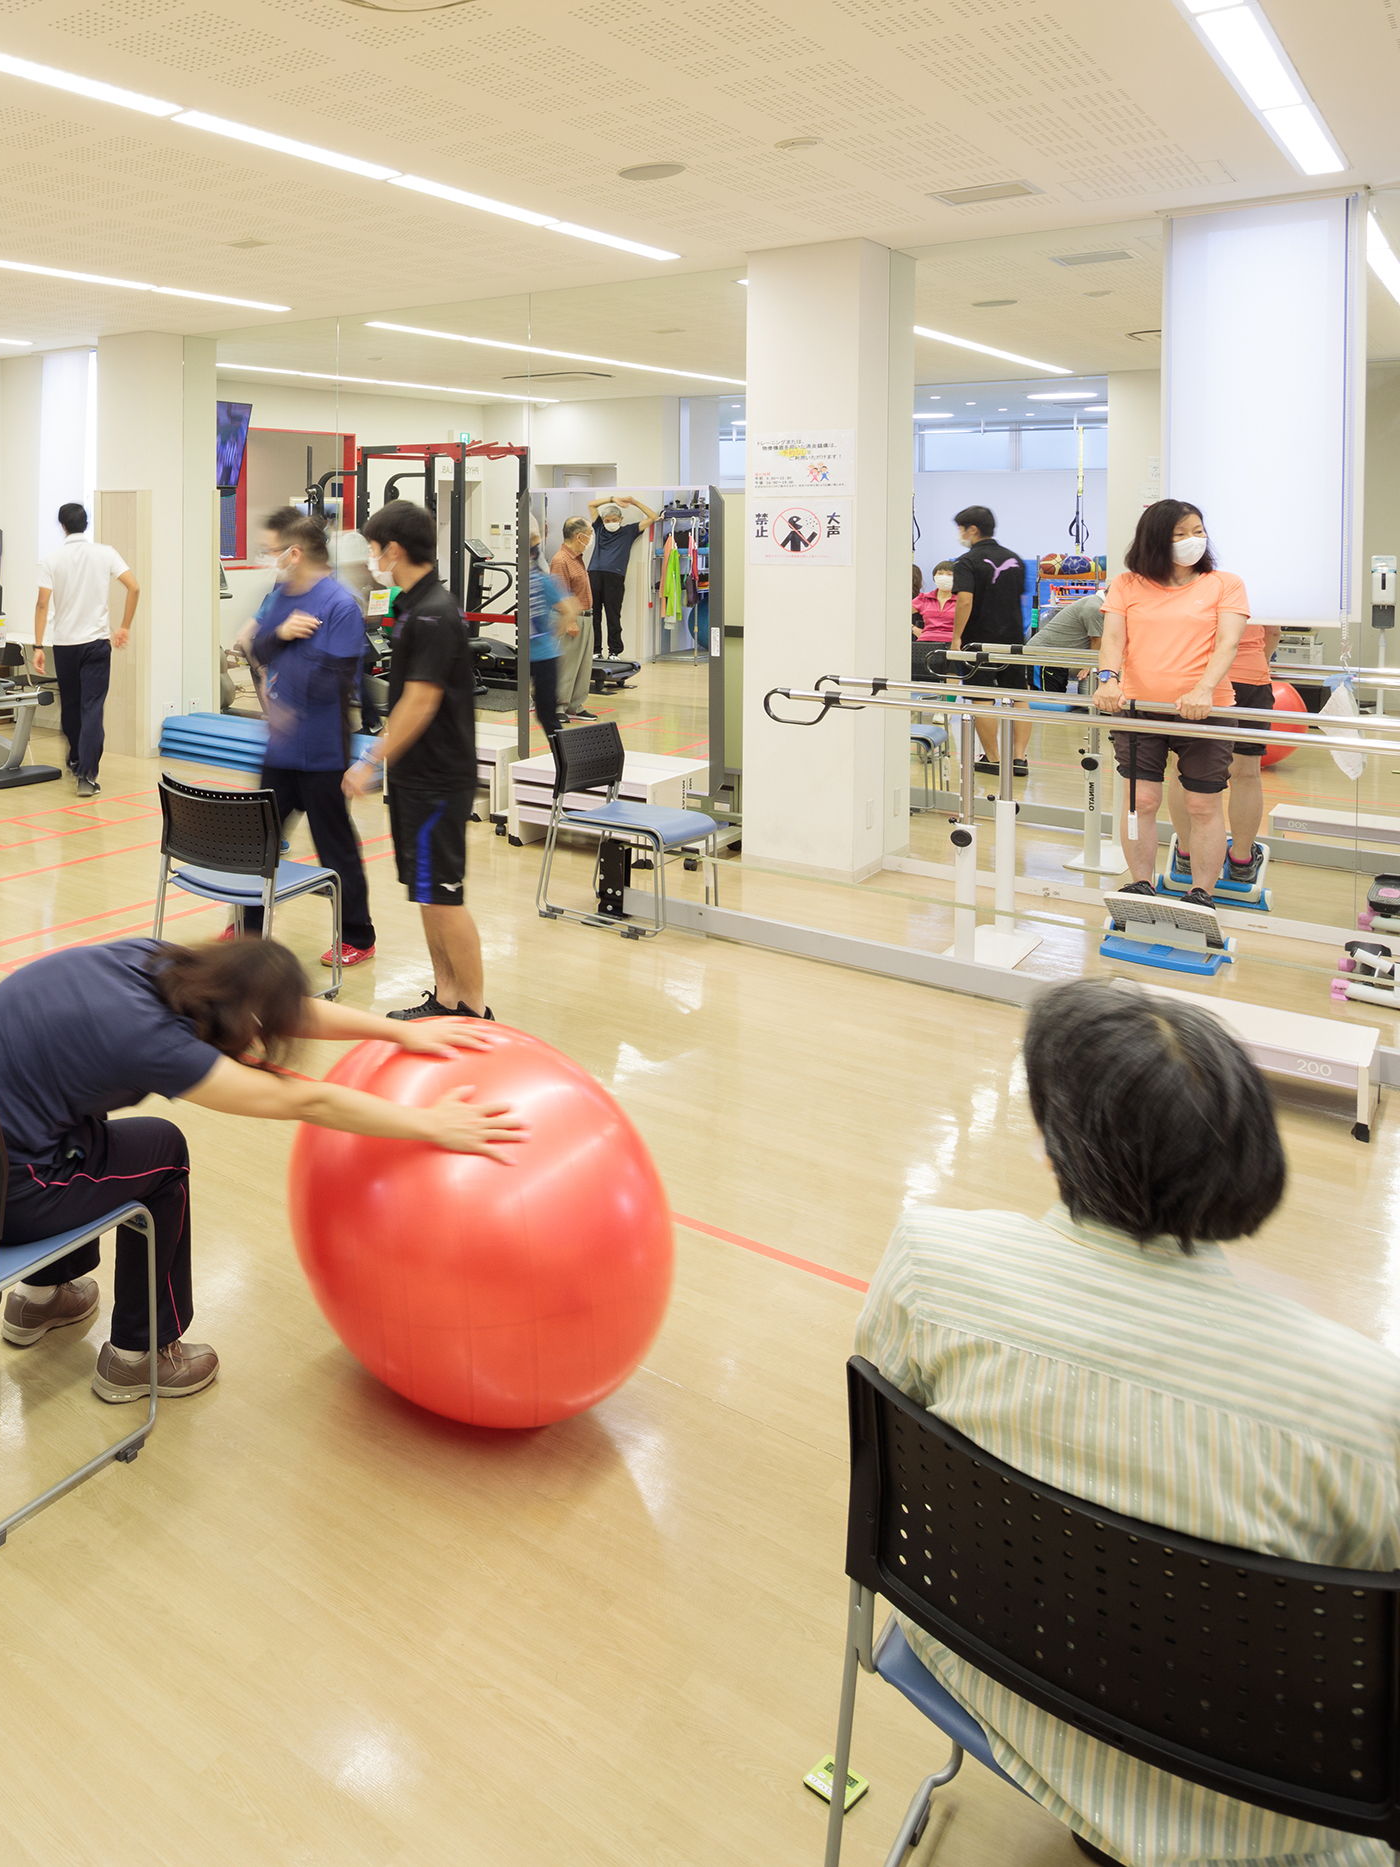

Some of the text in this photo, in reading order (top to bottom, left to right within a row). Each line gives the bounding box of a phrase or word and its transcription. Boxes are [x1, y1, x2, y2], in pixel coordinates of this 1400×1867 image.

[755, 513, 769, 538] 禁止
[826, 512, 841, 538] 大声
[1296, 1059, 1332, 1077] 200
